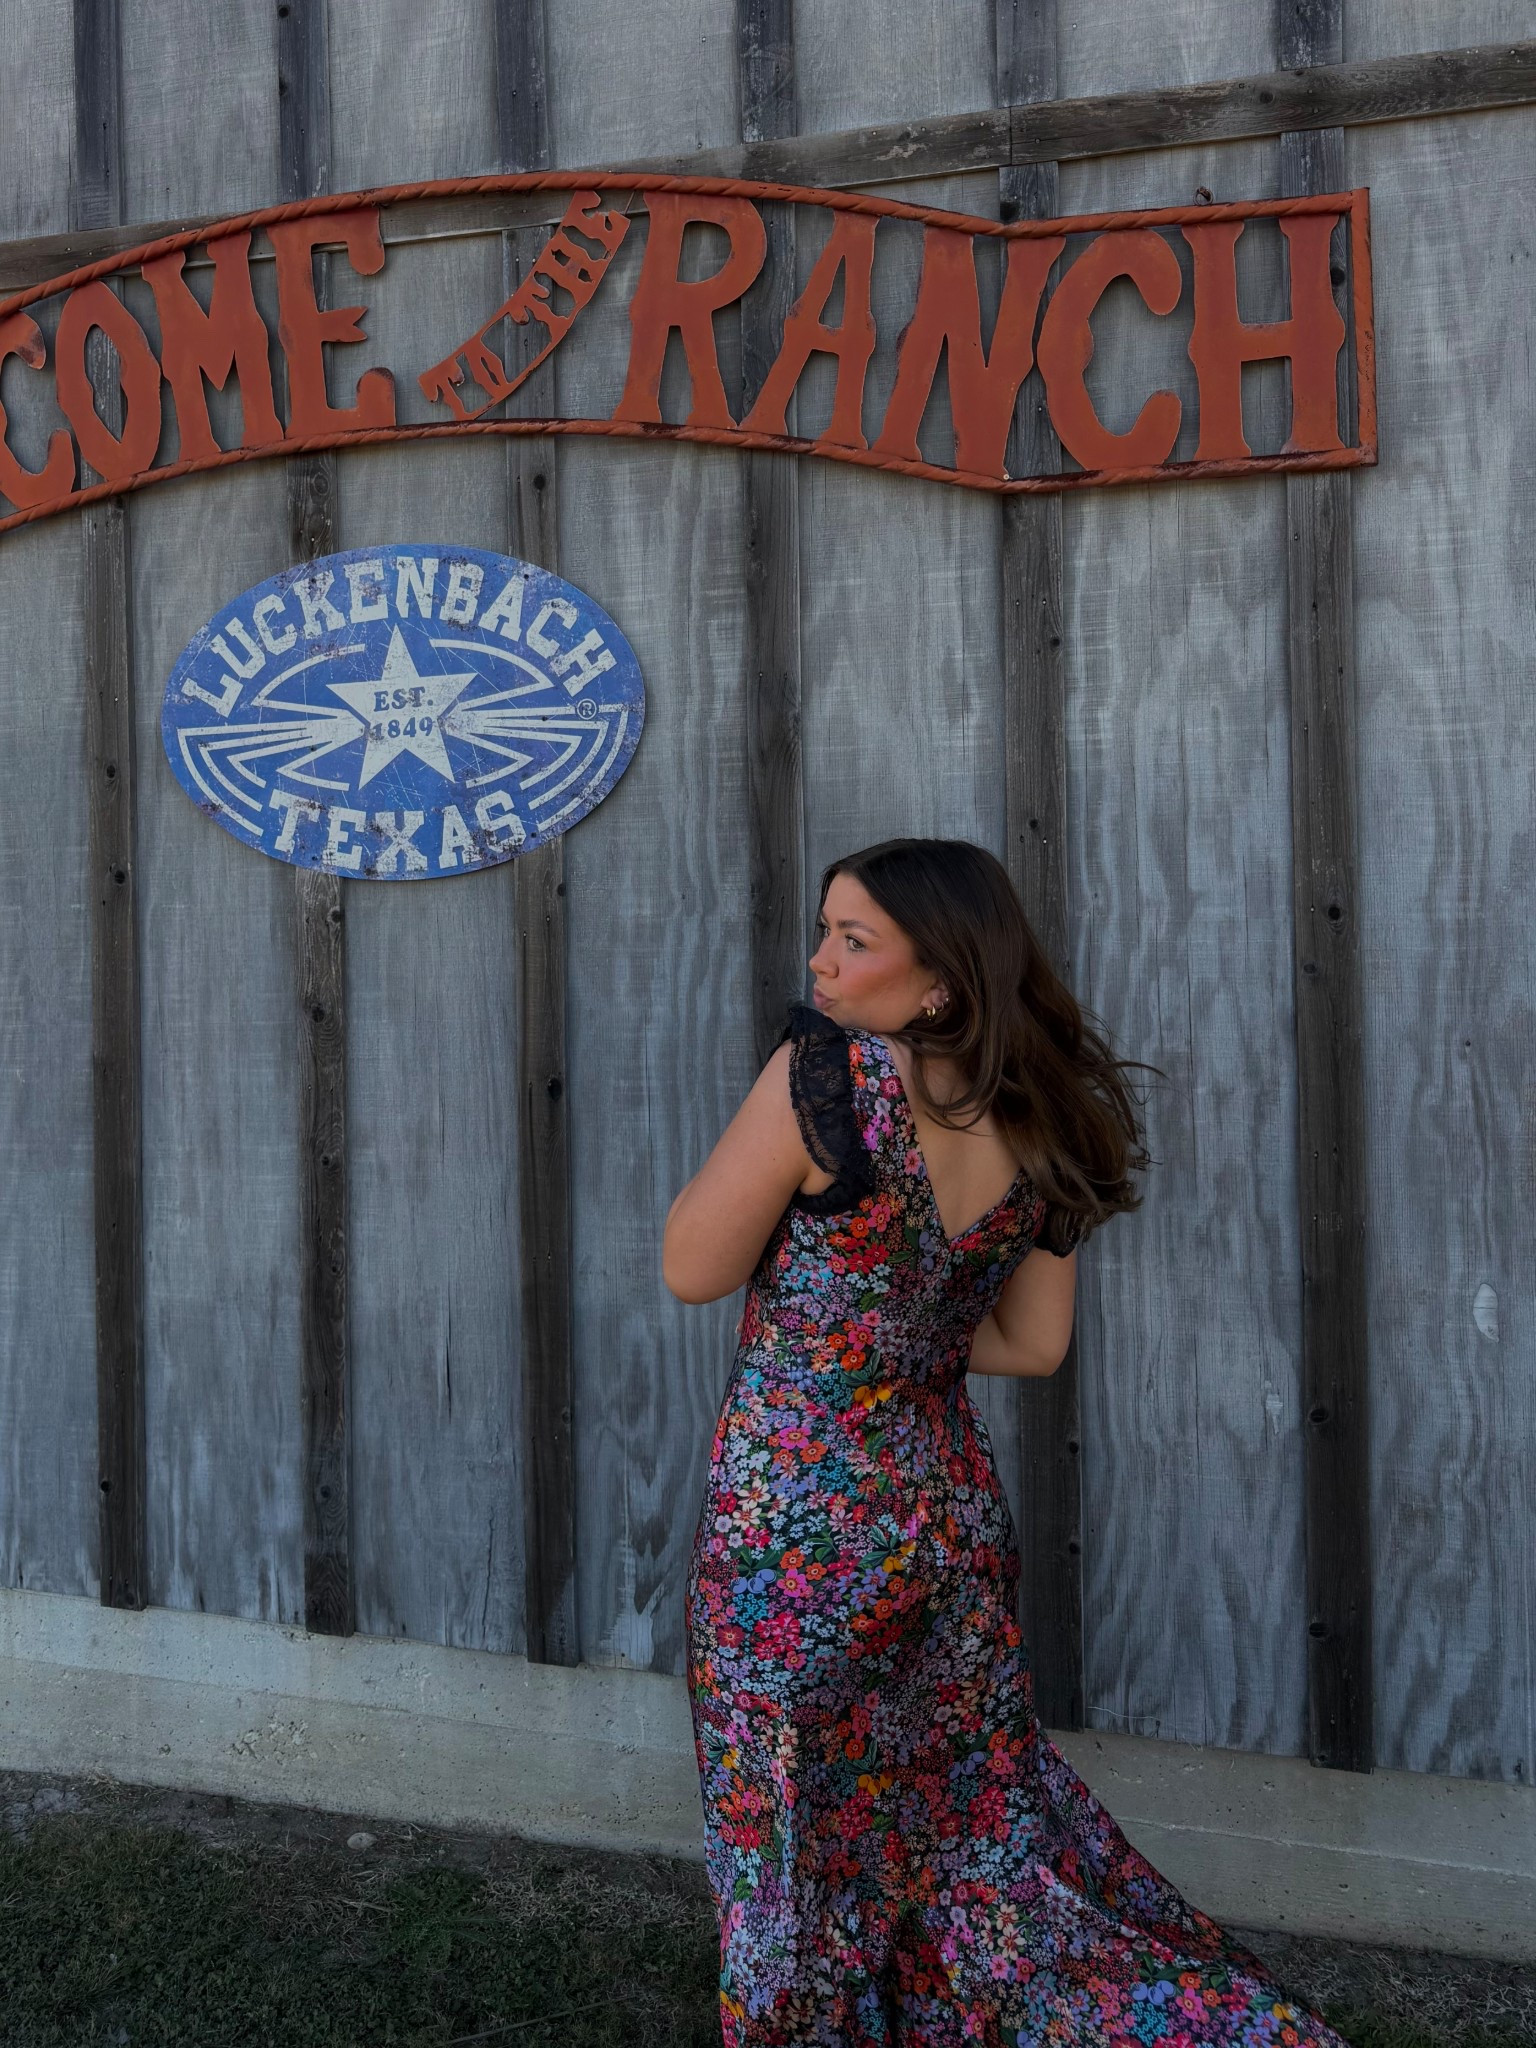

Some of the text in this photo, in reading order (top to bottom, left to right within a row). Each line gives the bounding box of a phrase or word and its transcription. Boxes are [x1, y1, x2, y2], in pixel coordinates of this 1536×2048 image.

[0, 189, 1346, 510] COME TO THE RANCH
[181, 556, 618, 718] LUCKENBACH
[372, 716, 434, 741] 1849
[373, 686, 434, 713] EST.
[268, 789, 527, 873] TEXAS
